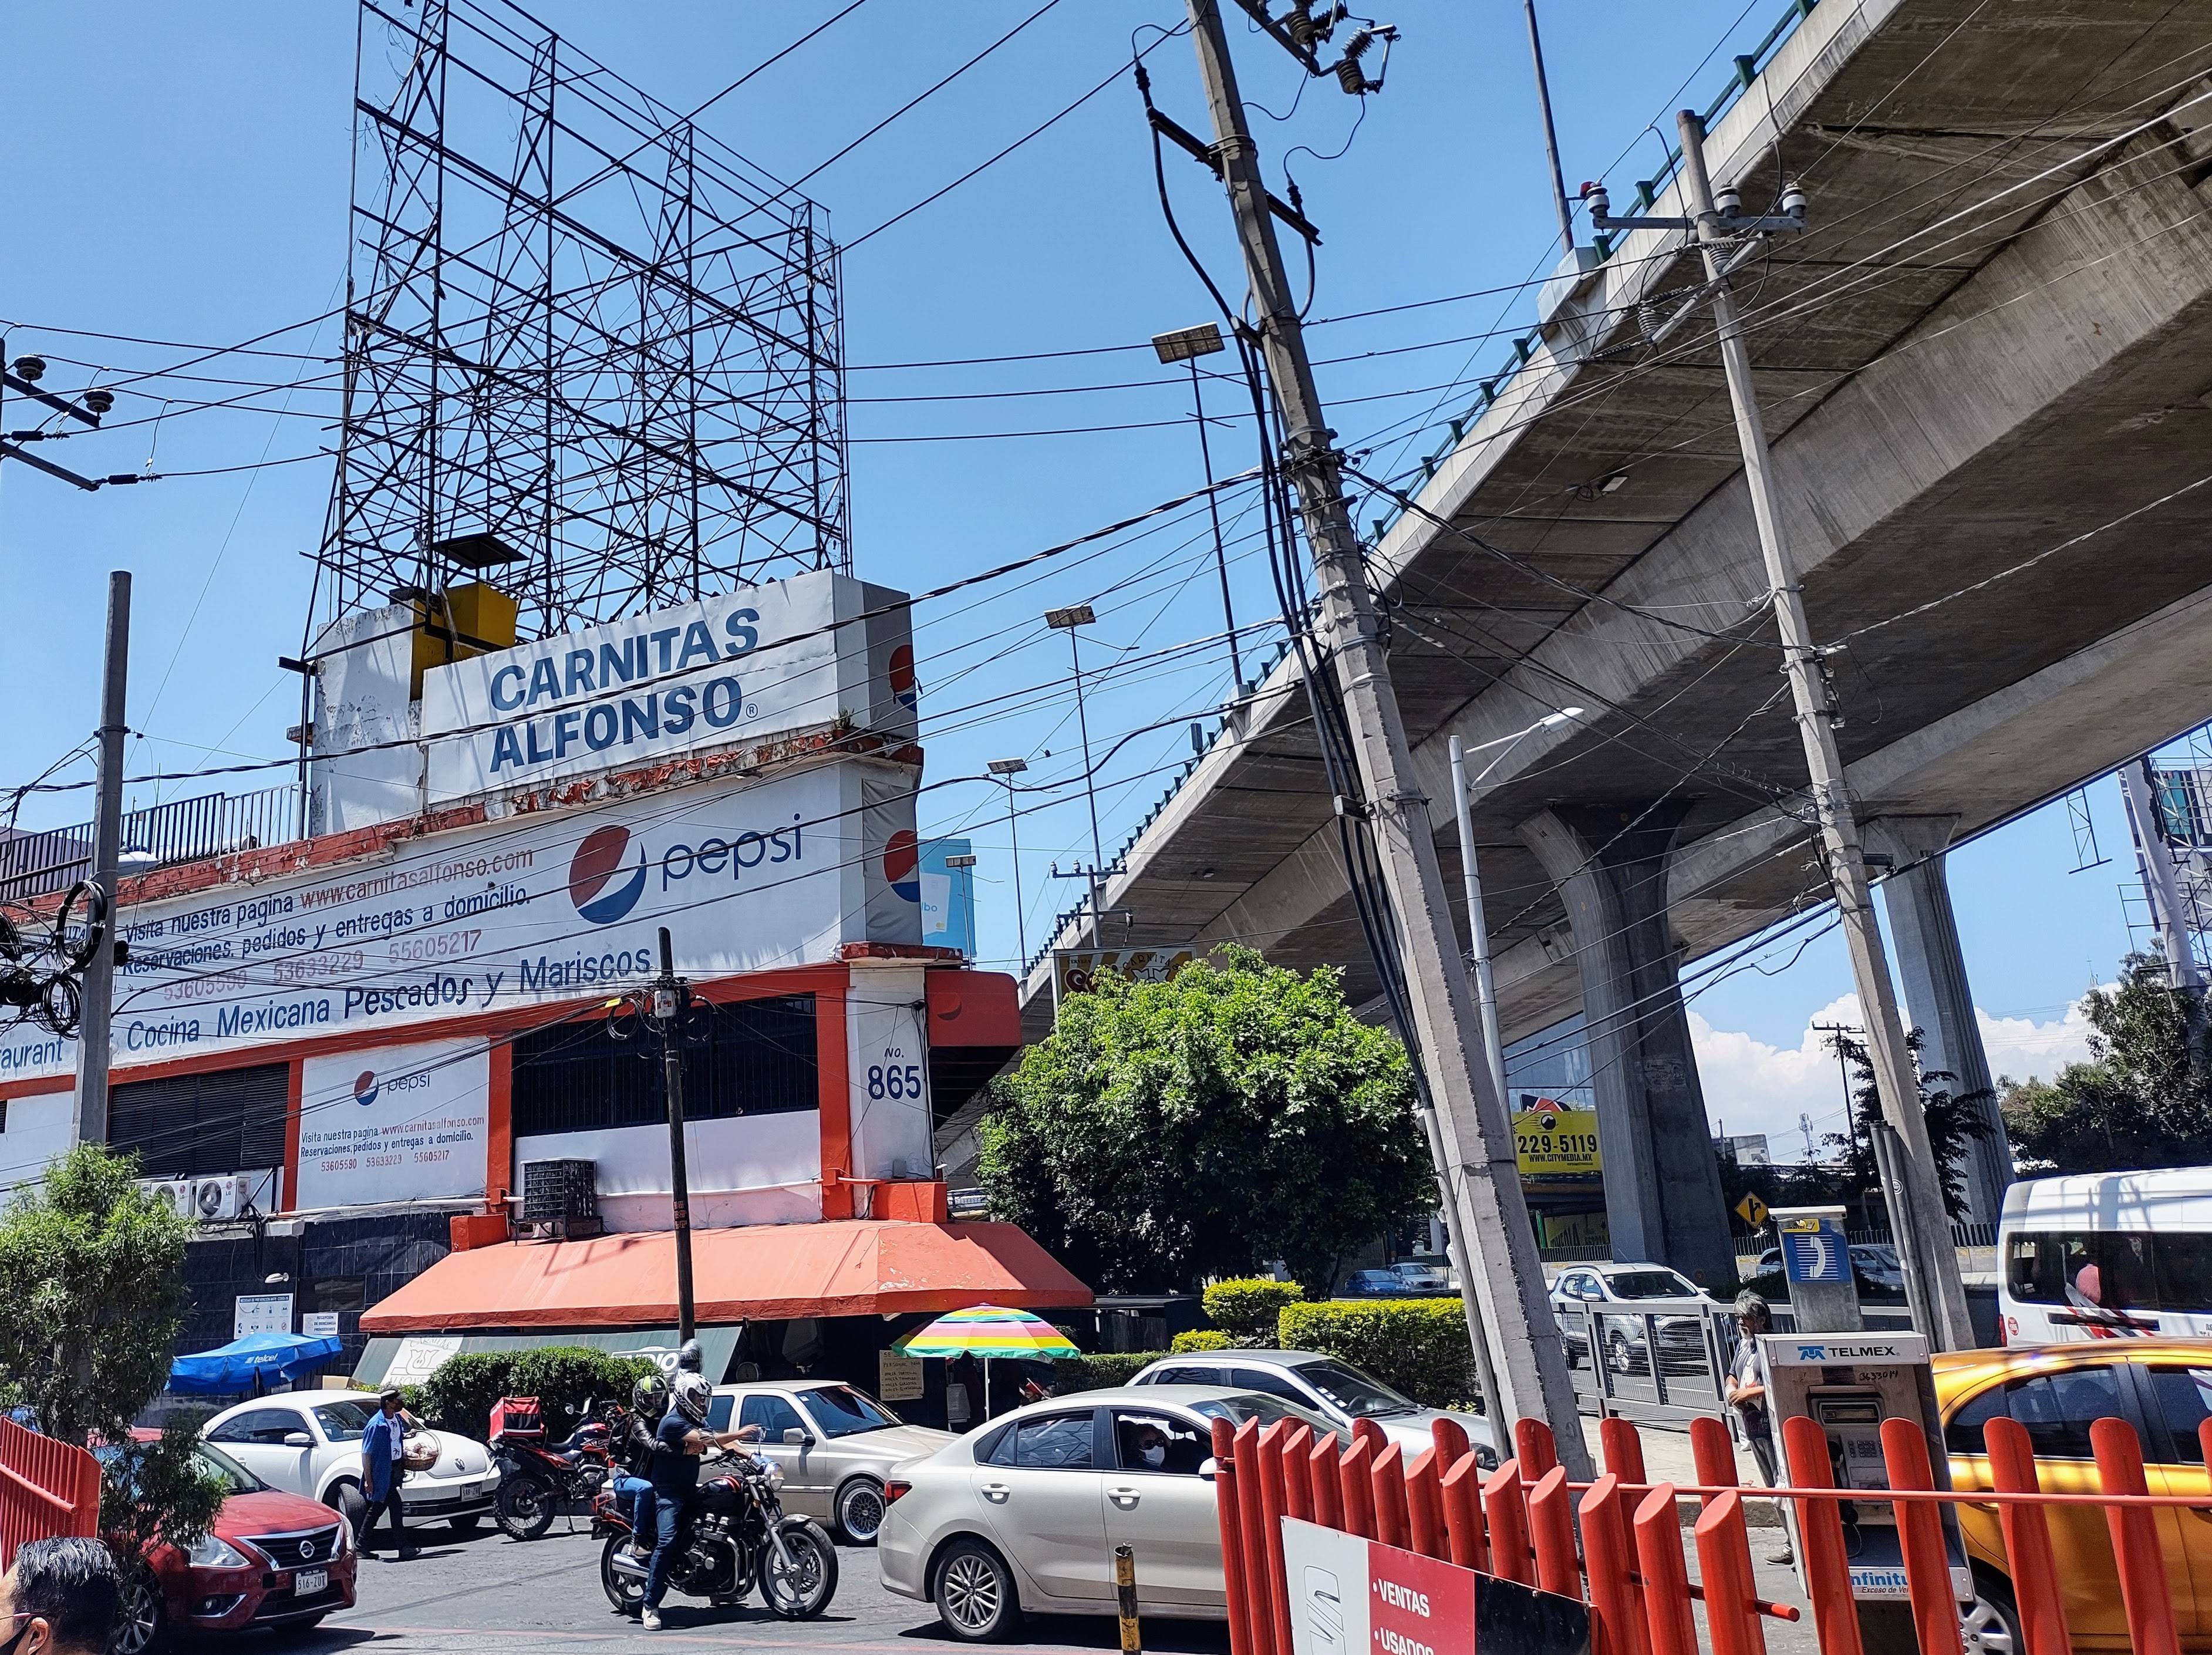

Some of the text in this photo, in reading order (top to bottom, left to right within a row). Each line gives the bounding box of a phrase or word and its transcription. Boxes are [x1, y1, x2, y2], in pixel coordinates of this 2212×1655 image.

[490, 607, 759, 712] CARNITAS
[489, 675, 743, 774] ALFONSO
[663, 813, 802, 892] pepsi
[125, 921, 164, 943] Visita
[171, 907, 231, 932] nuestra
[237, 894, 294, 929] pagina
[242, 926, 306, 960] pedidos
[313, 923, 326, 949] y
[336, 905, 413, 938] entregas
[422, 906, 433, 922] a
[388, 928, 482, 963] 55605217
[0, 948, 651, 1069] aurant Cocina Mexicana Pescados y Mariscos
[387, 1071, 430, 1096] pepsi
[867, 1065, 922, 1100] 865
[301, 1116, 484, 1144] Visita nuestra pagina www.carnitasalfonso.com
[353, 1140, 382, 1155] pedidos
[384, 1141, 389, 1152] y
[391, 1136, 424, 1150] entregas
[429, 1136, 434, 1144] a
[436, 1130, 474, 1144] domicilio.
[1518, 1134, 1597, 1154] 229-5119
[414, 1150, 450, 1163] 55605217
[1528, 1154, 1593, 1162] WWW.CITYMEDIA.MX
[254, 1353, 278, 1363] telcel
[1828, 1346, 1896, 1357] TELMEX
[1377, 1578, 1431, 1618] VENTAS
